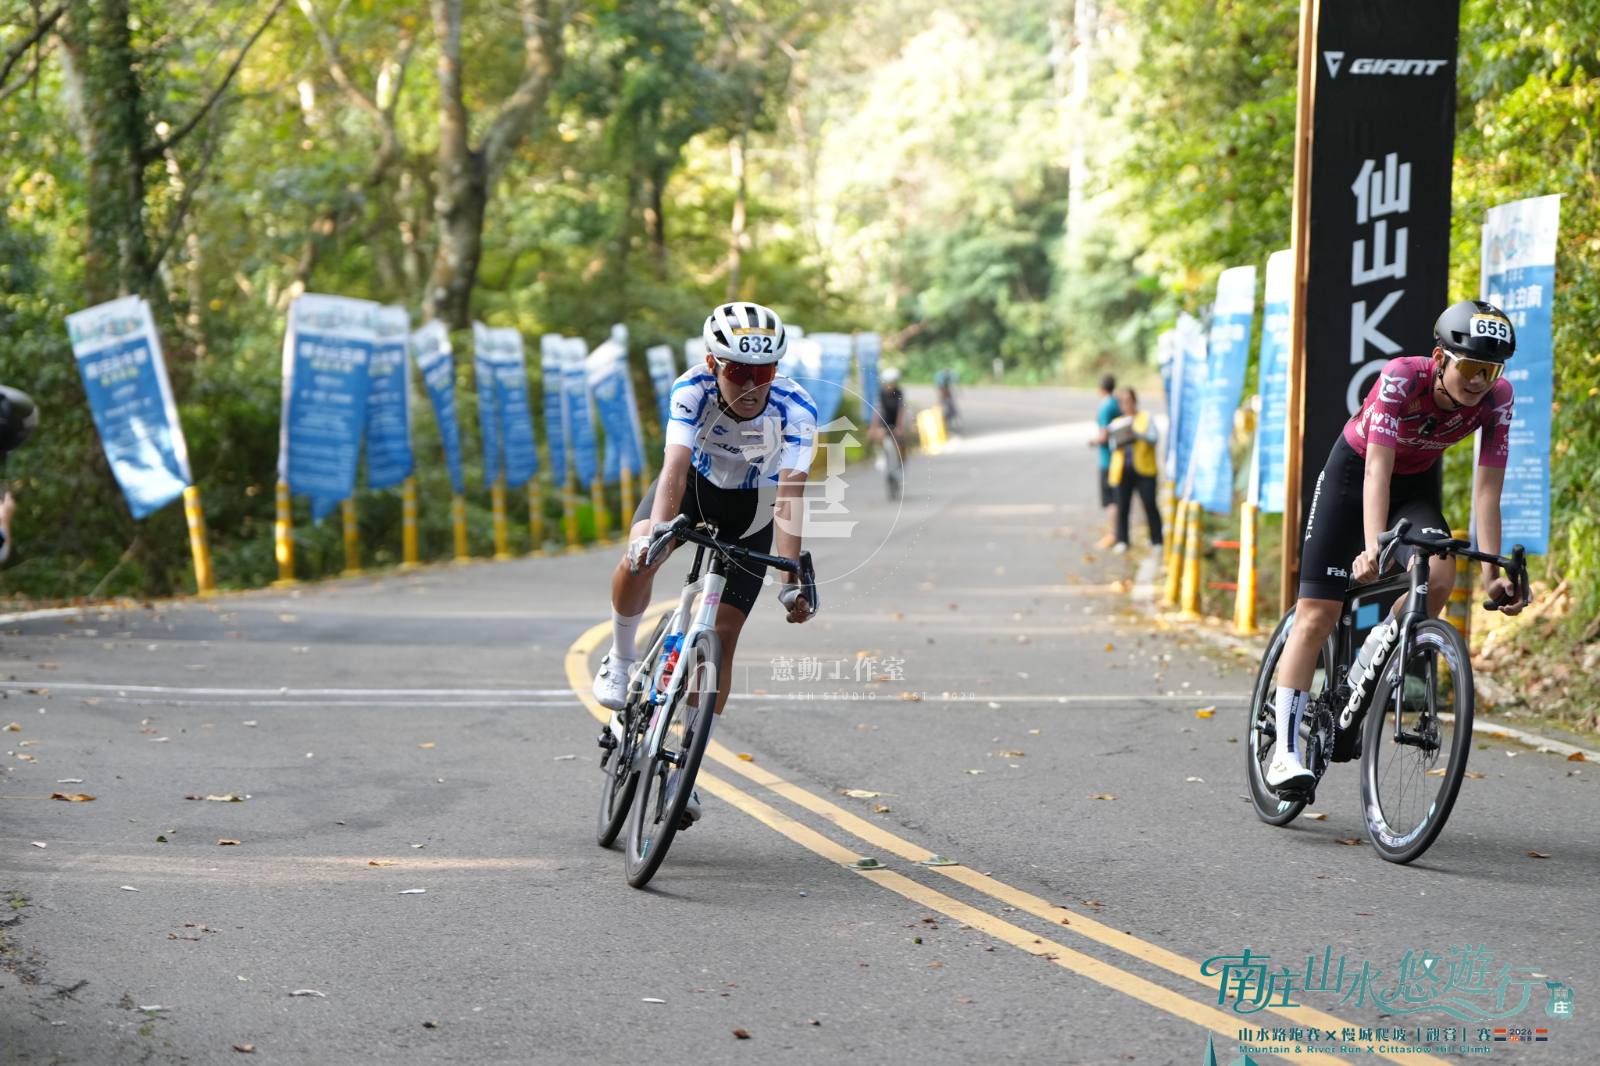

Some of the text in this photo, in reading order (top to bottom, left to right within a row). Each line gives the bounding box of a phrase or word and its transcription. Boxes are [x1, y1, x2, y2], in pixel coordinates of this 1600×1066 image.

[1350, 58, 1449, 76] GIANT
[1476, 319, 1507, 338] 655
[738, 336, 773, 354] 632
